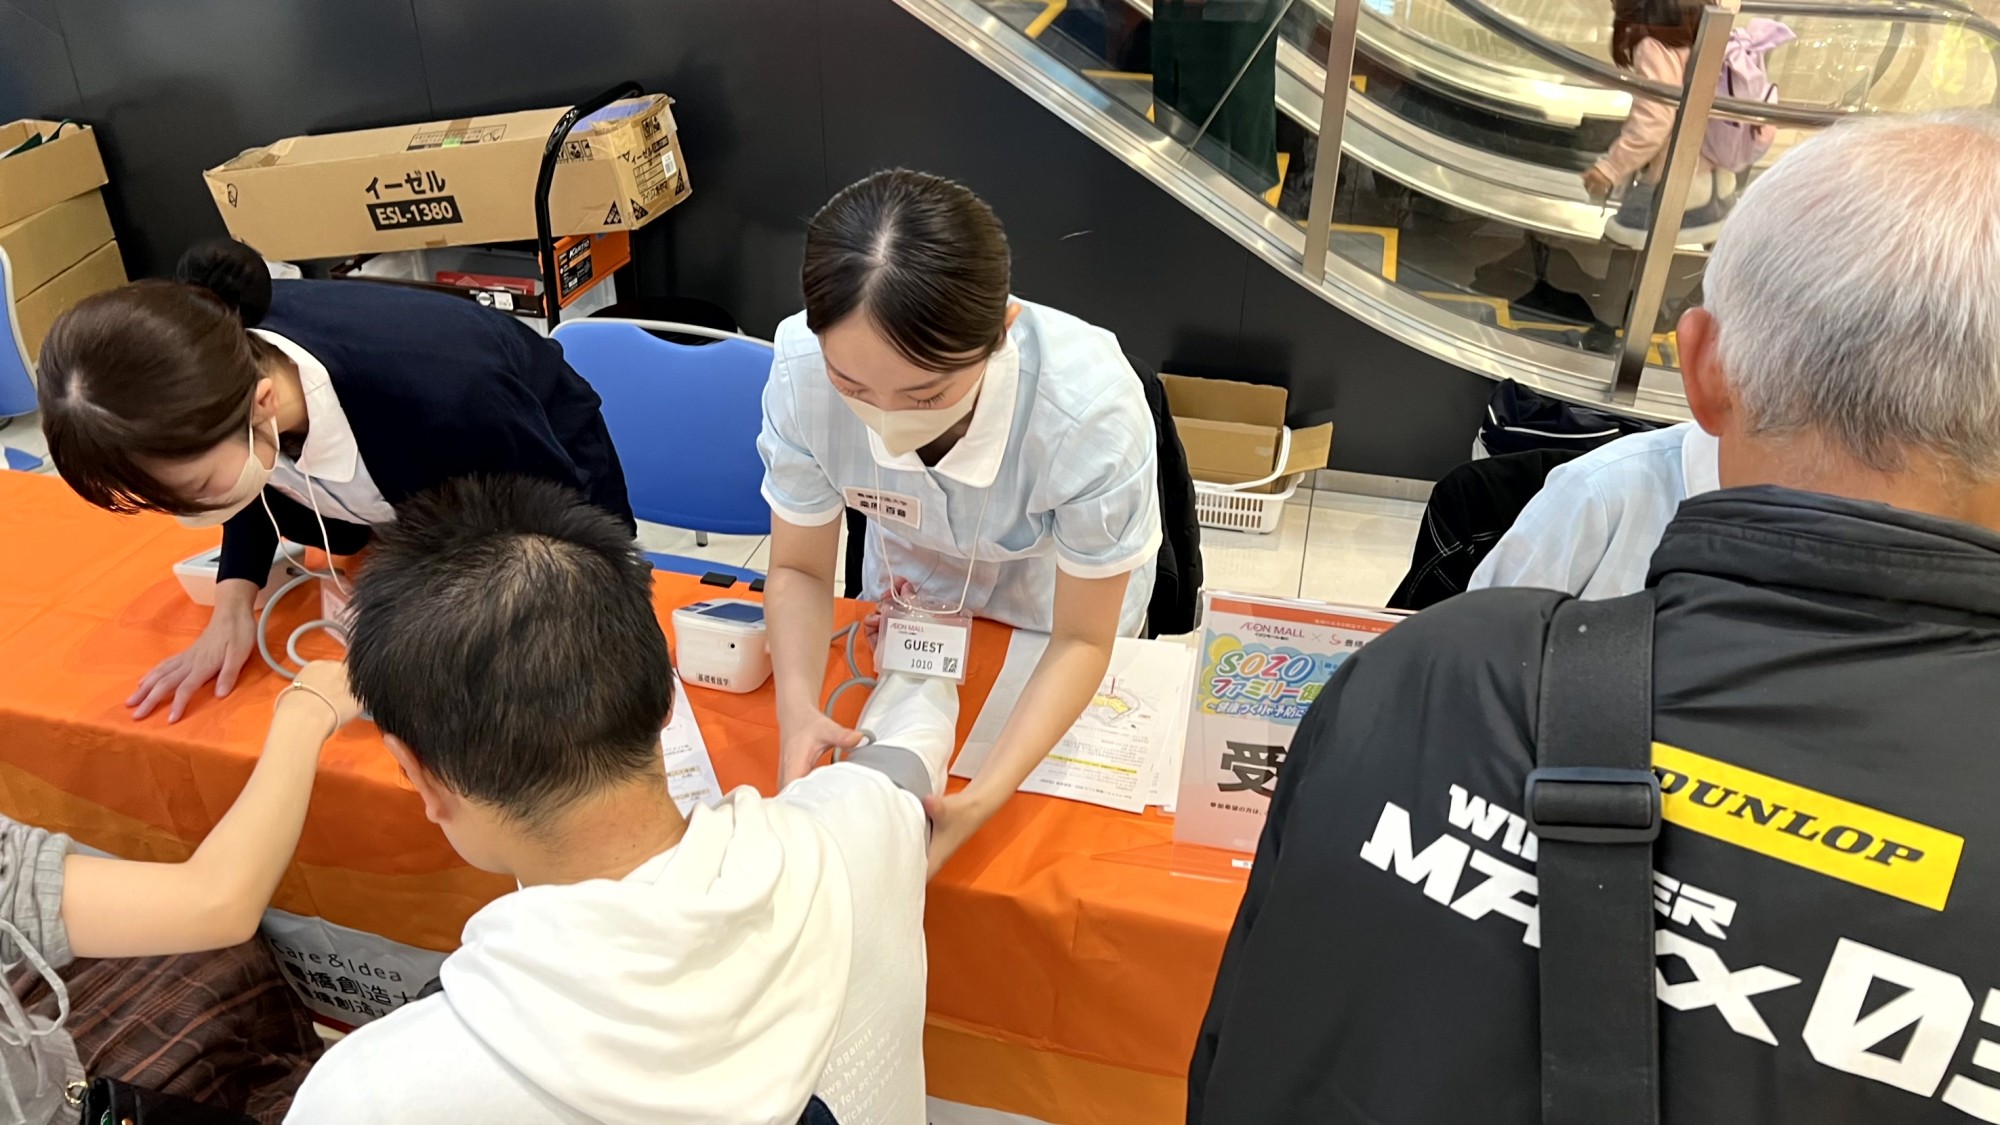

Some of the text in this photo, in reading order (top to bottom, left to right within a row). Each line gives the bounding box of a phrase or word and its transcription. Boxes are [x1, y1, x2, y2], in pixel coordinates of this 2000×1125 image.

[365, 170, 446, 200] イーゼル
[375, 201, 453, 225] ESL-1380
[1273, 625, 1305, 638] MALL
[904, 639, 944, 654] GUEST
[910, 658, 933, 670] 1010
[1217, 652, 1312, 681] SOZO
[1653, 766, 1925, 867] DUNLOP
